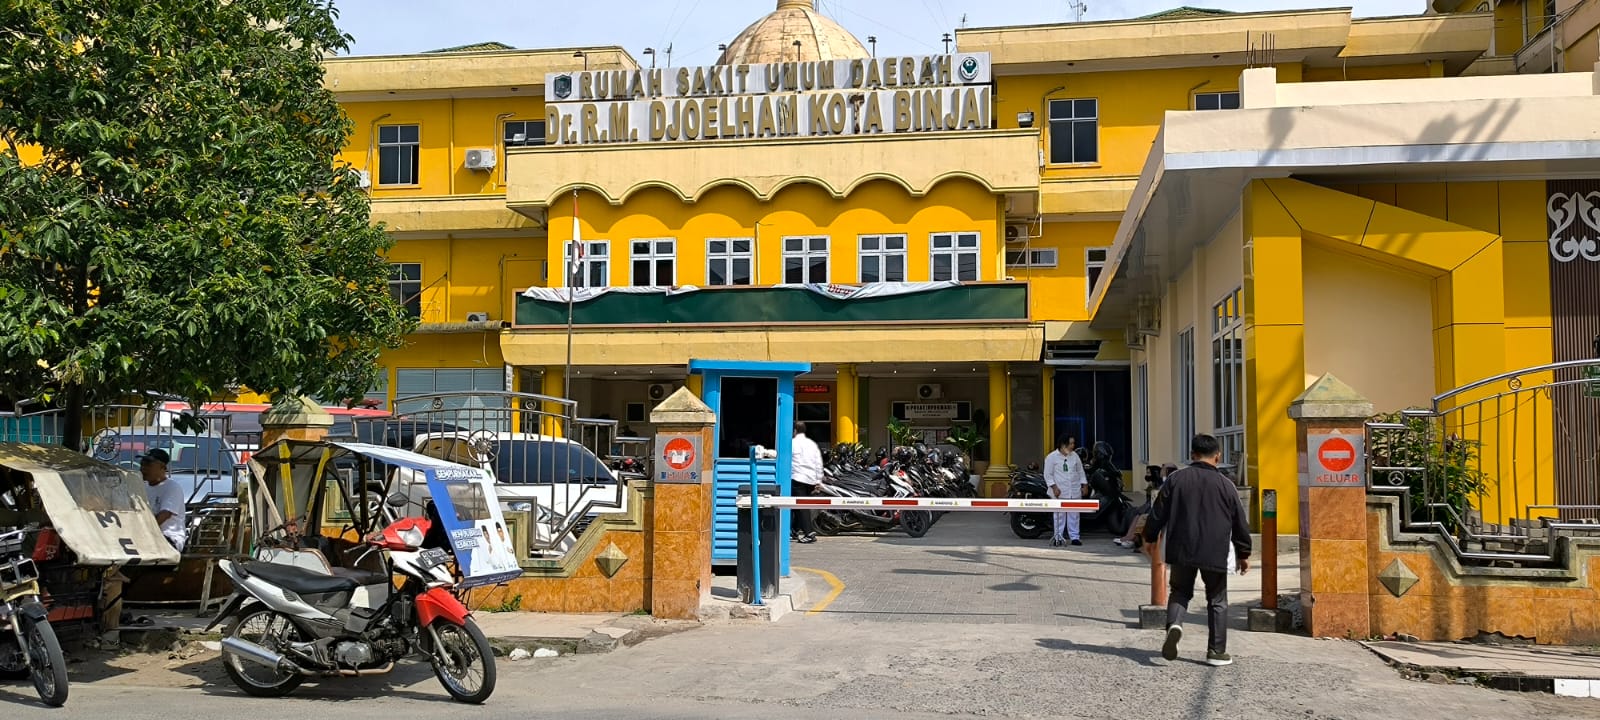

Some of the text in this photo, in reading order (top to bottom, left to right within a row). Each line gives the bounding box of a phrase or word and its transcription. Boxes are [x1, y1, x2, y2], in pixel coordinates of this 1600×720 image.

[579, 54, 952, 99] RUMAH SAKIT UMUM DAERAH
[651, 95, 798, 141] DJOELHAM
[808, 91, 883, 135] KOTA
[894, 87, 990, 132] BINJAI
[1316, 473, 1359, 483] KELUAR
